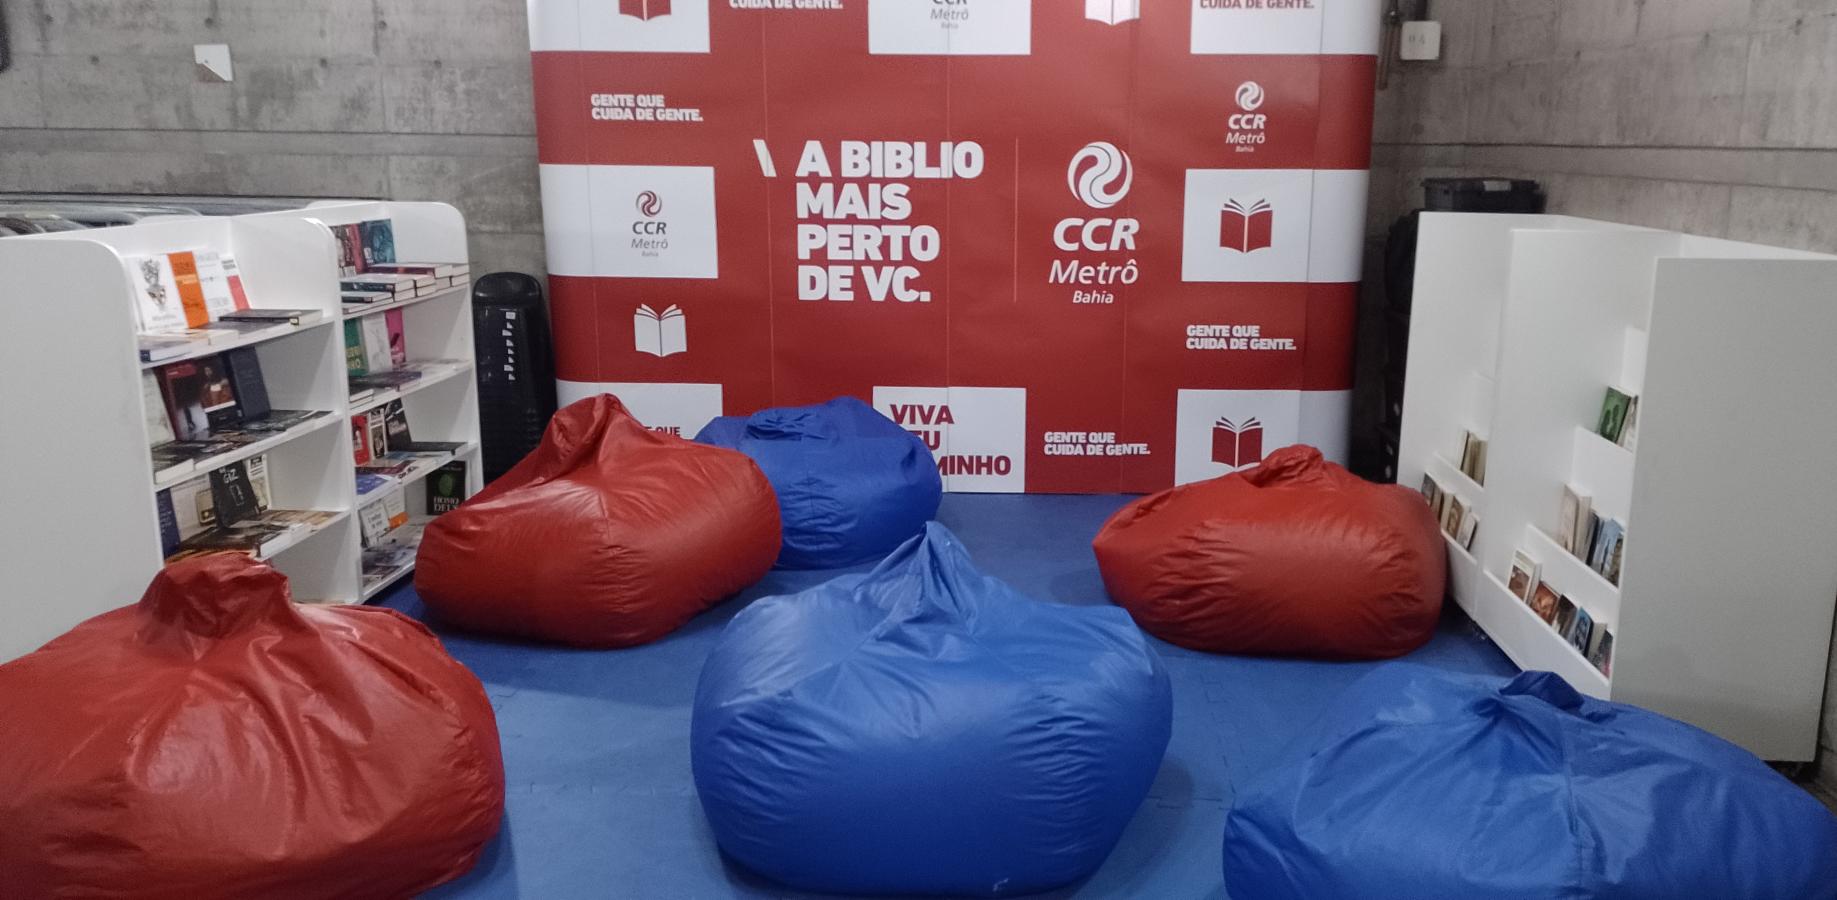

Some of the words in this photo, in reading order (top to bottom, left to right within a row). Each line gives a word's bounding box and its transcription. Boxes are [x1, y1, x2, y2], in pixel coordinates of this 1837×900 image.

[729, 0, 772, 9] CUIDA
[774, 0, 793, 9] DE
[795, 0, 844, 9] GENTE.
[1200, 0, 1242, 9] CUIDA
[1246, 0, 1263, 9] DE
[1267, 0, 1315, 9] GENTE.
[591, 94, 635, 107] GENTE
[637, 94, 665, 107] QUE
[592, 107, 634, 120] CUIDA
[636, 108, 655, 120] DE
[656, 108, 704, 121] GENTE.
[1228, 114, 1267, 129] CCR
[1225, 132, 1265, 144] Metrô
[795, 140, 832, 177] A
[841, 140, 985, 179] BIBLIO
[796, 182, 912, 220] MAIS
[632, 221, 667, 235] CCR
[1053, 217, 1140, 251] CCR
[631, 238, 669, 249] Metrô
[797, 224, 941, 262] PERTO
[1048, 258, 1139, 284] Metrô
[798, 265, 854, 301] DE
[861, 266, 931, 302] VC.
[1072, 289, 1114, 304] Bahia
[1186, 325, 1230, 336] GENTE
[1232, 325, 1260, 337] QUE
[1186, 338, 1228, 349] CUIDA
[1229, 338, 1248, 349] DE
[1250, 339, 1297, 350] GENTE.
[890, 404, 955, 425] VIVA
[1044, 432, 1087, 443] GENTE
[1088, 432, 1116, 443] QUE
[1044, 444, 1085, 455] CUIDA
[1086, 444, 1104, 455] DE
[1105, 443, 1151, 456] GENTE.
